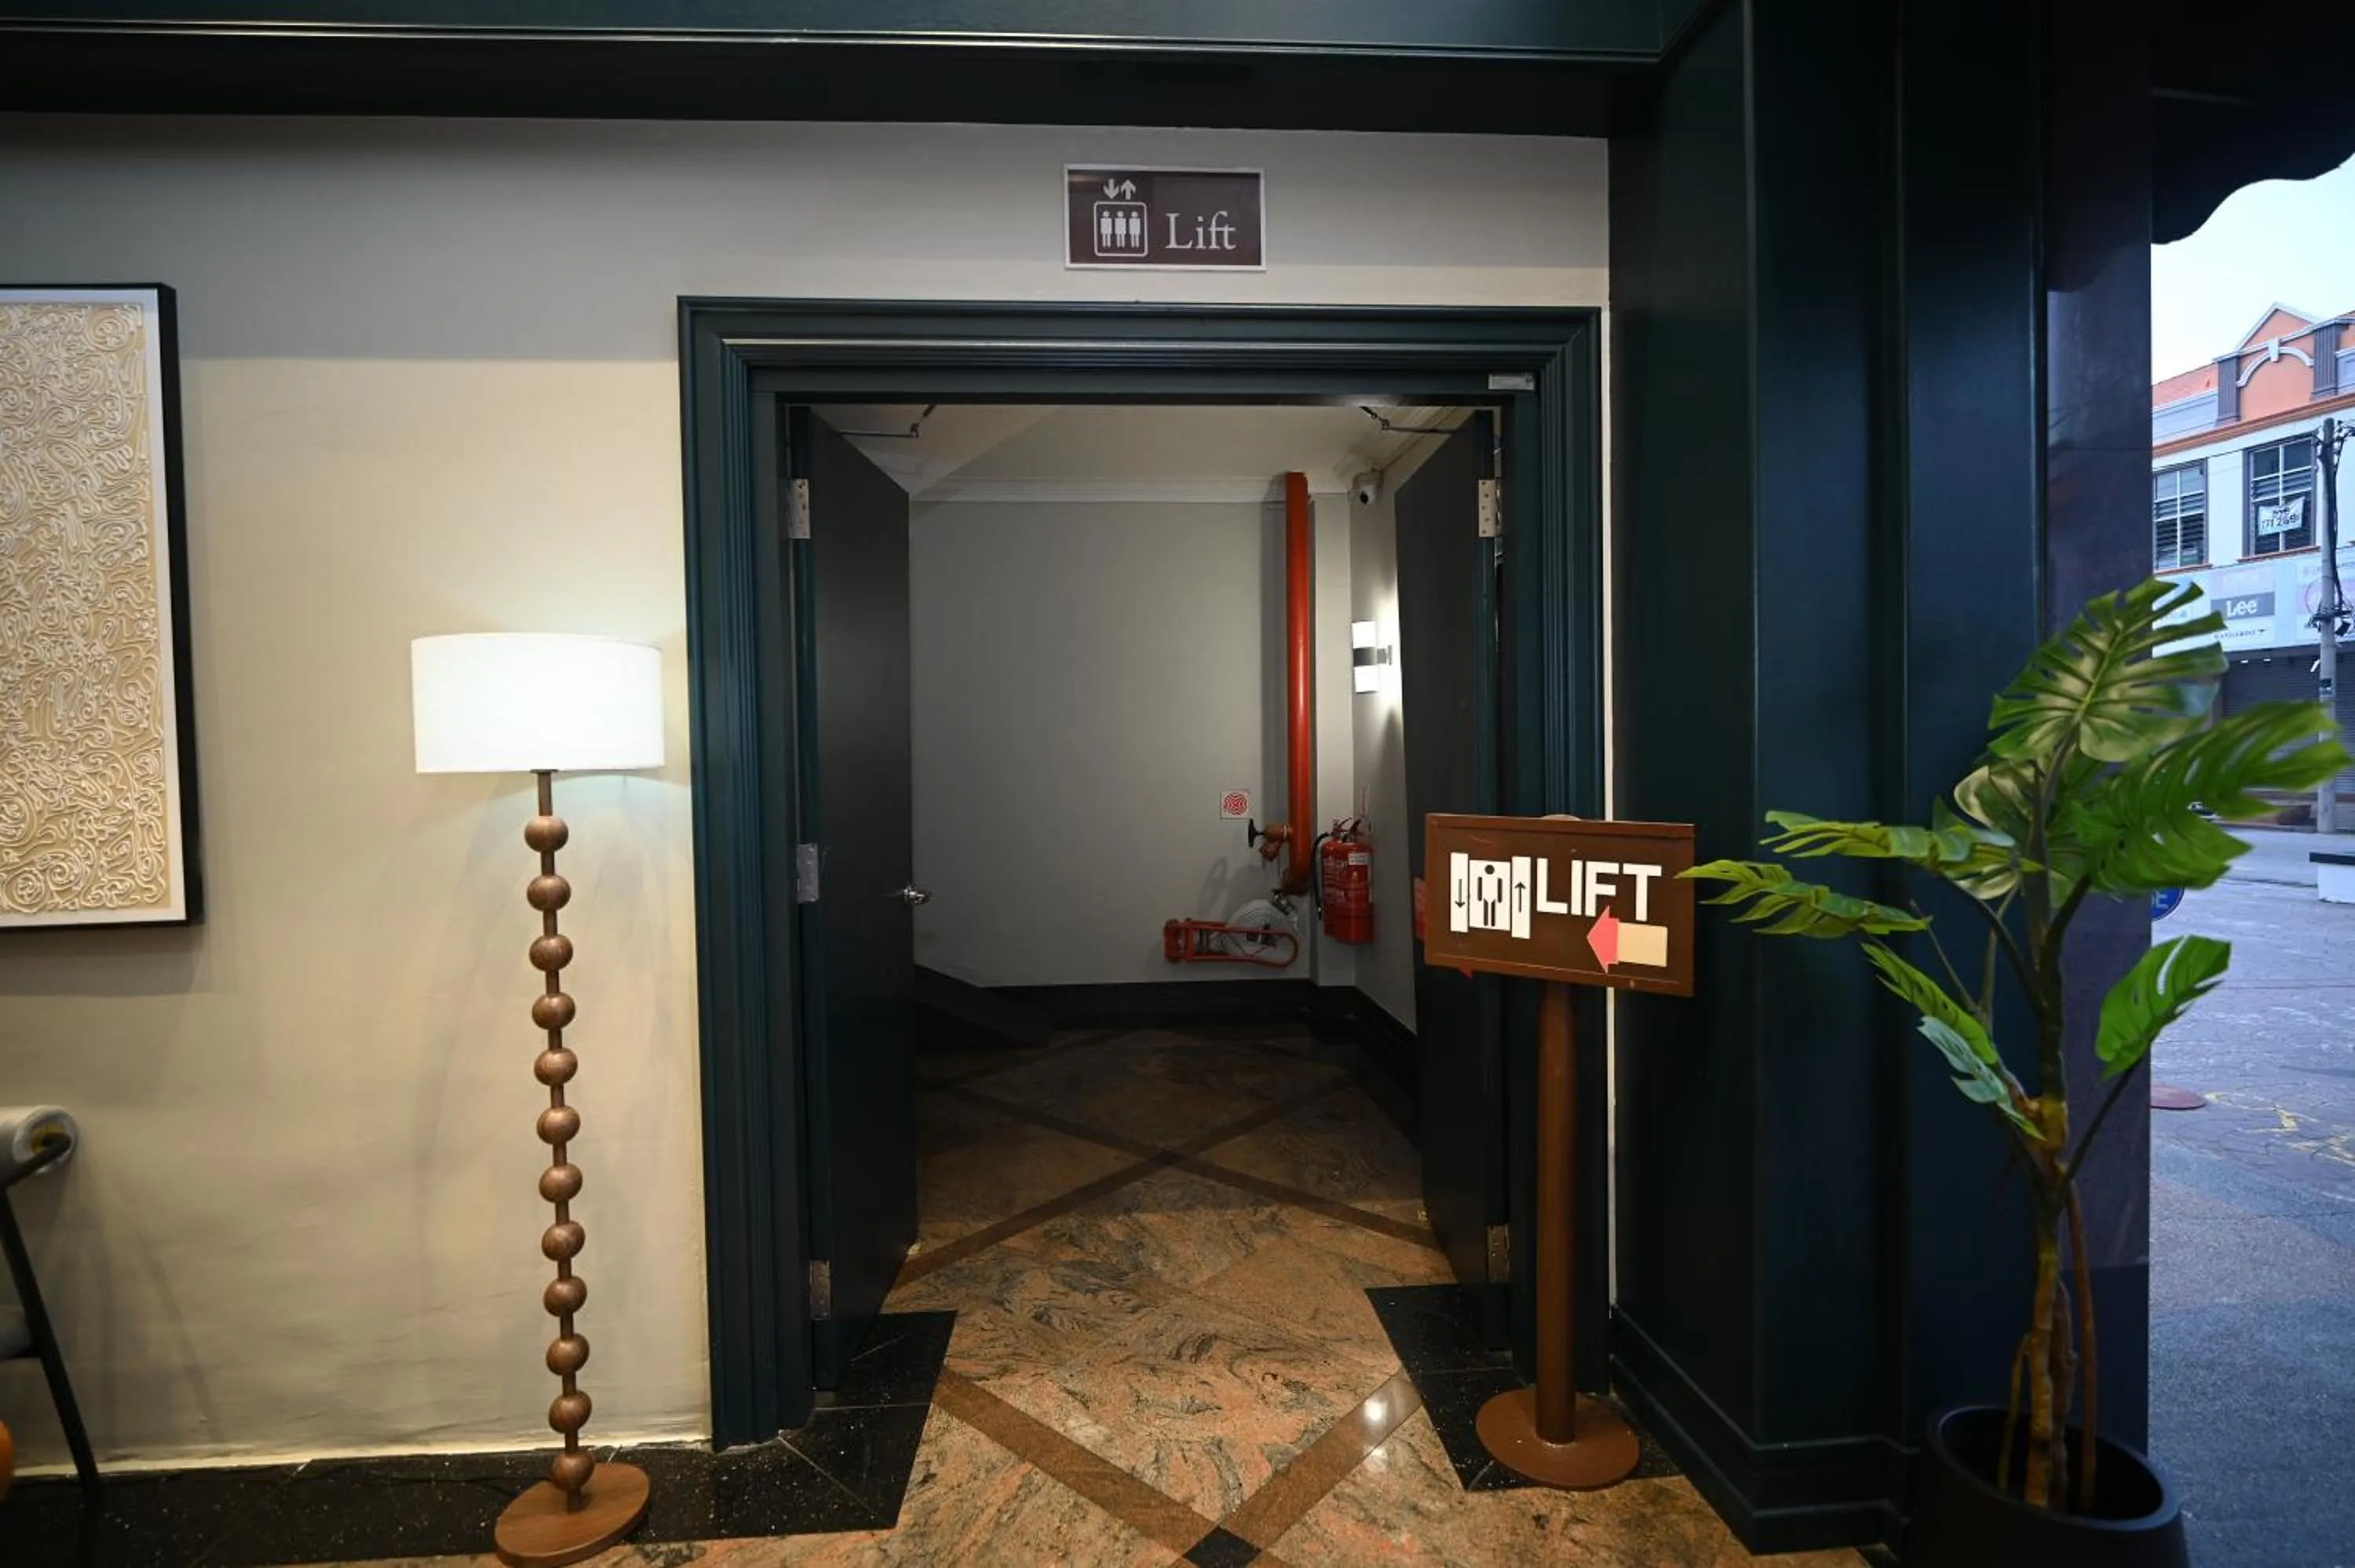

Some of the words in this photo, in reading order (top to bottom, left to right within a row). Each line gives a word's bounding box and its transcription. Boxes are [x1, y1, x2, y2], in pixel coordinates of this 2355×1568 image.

[1164, 210, 1236, 250] Lift
[2225, 600, 2258, 616] Lee
[1536, 857, 1662, 922] LIFT
